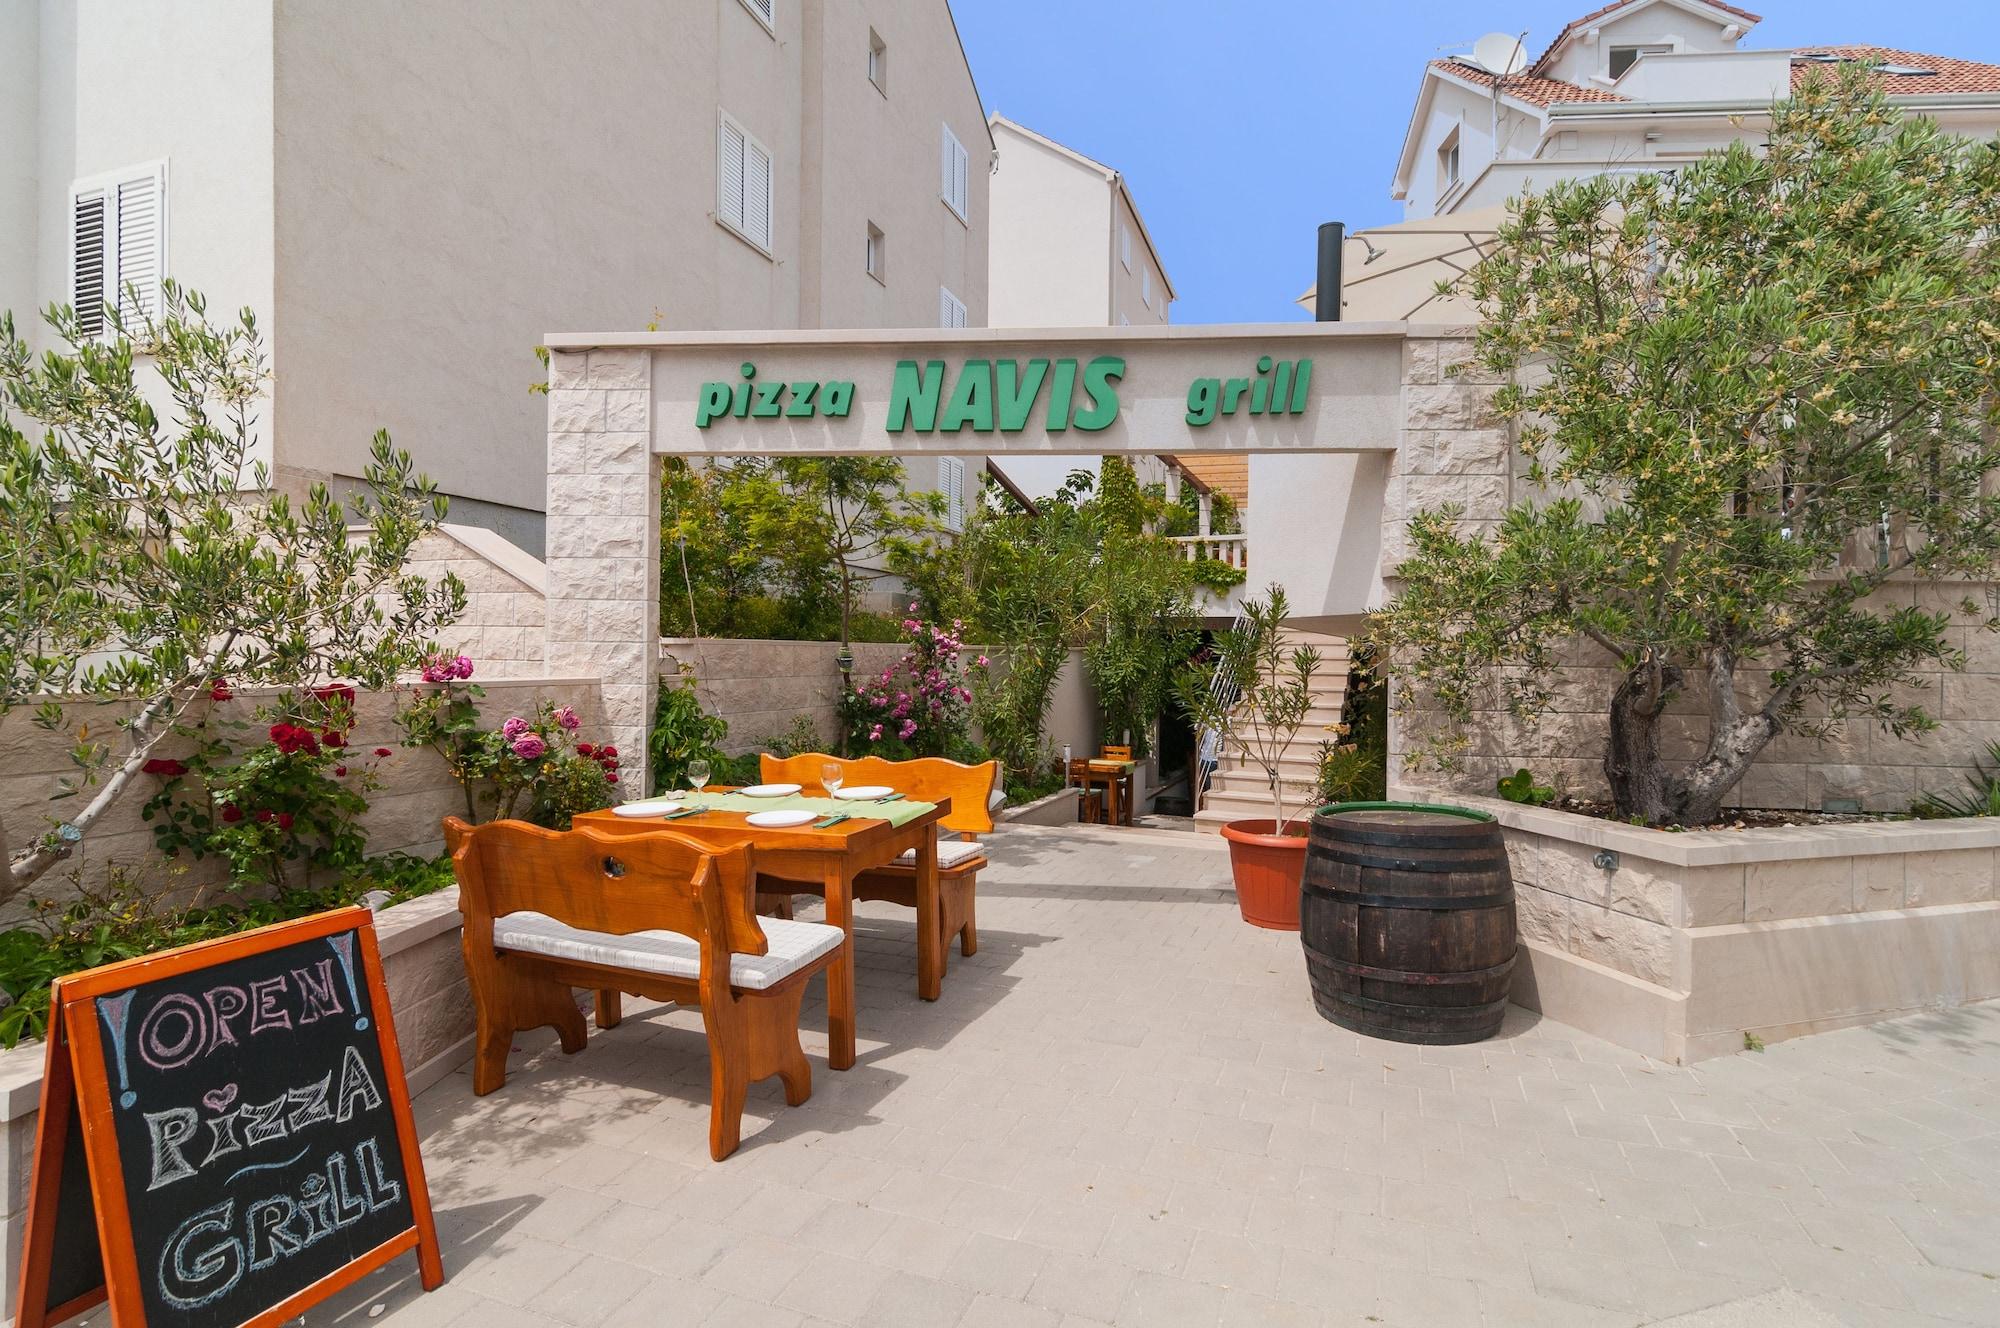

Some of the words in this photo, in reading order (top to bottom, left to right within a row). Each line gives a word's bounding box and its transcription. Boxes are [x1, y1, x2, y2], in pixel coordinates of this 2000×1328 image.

[696, 362, 855, 428] pizza
[886, 357, 1126, 432] NAVIS
[1186, 355, 1313, 426] grill
